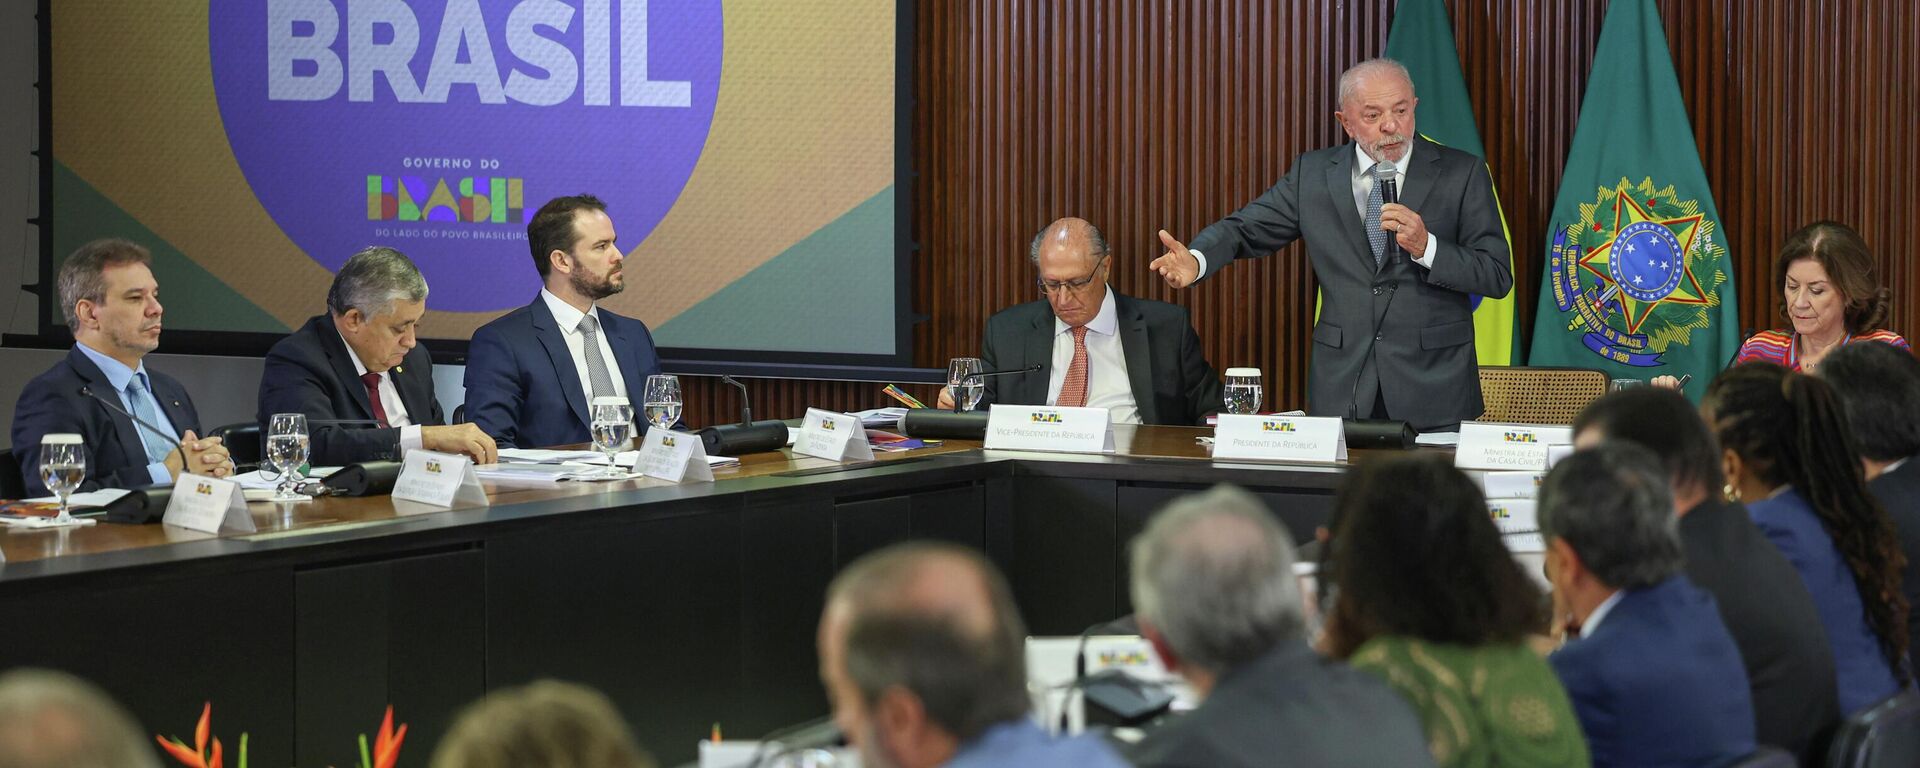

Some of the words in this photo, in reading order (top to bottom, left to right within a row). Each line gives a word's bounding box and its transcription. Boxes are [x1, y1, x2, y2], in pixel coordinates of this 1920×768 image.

[268, 0, 692, 107] BRASIL
[403, 157, 472, 169] GOVERNO
[480, 159, 500, 169] DO
[367, 175, 539, 224] BRASIL
[375, 229, 390, 237] DO
[393, 229, 420, 238] LADO
[423, 230, 438, 238] DO
[442, 230, 469, 239] POVO
[1552, 244, 1562, 253] 15
[1552, 271, 1566, 307] Novembro
[1574, 294, 1603, 333] FEDERATIVA
[1604, 328, 1615, 340] DO
[1617, 334, 1643, 349] BRASIL
[1613, 351, 1630, 363] 1889
